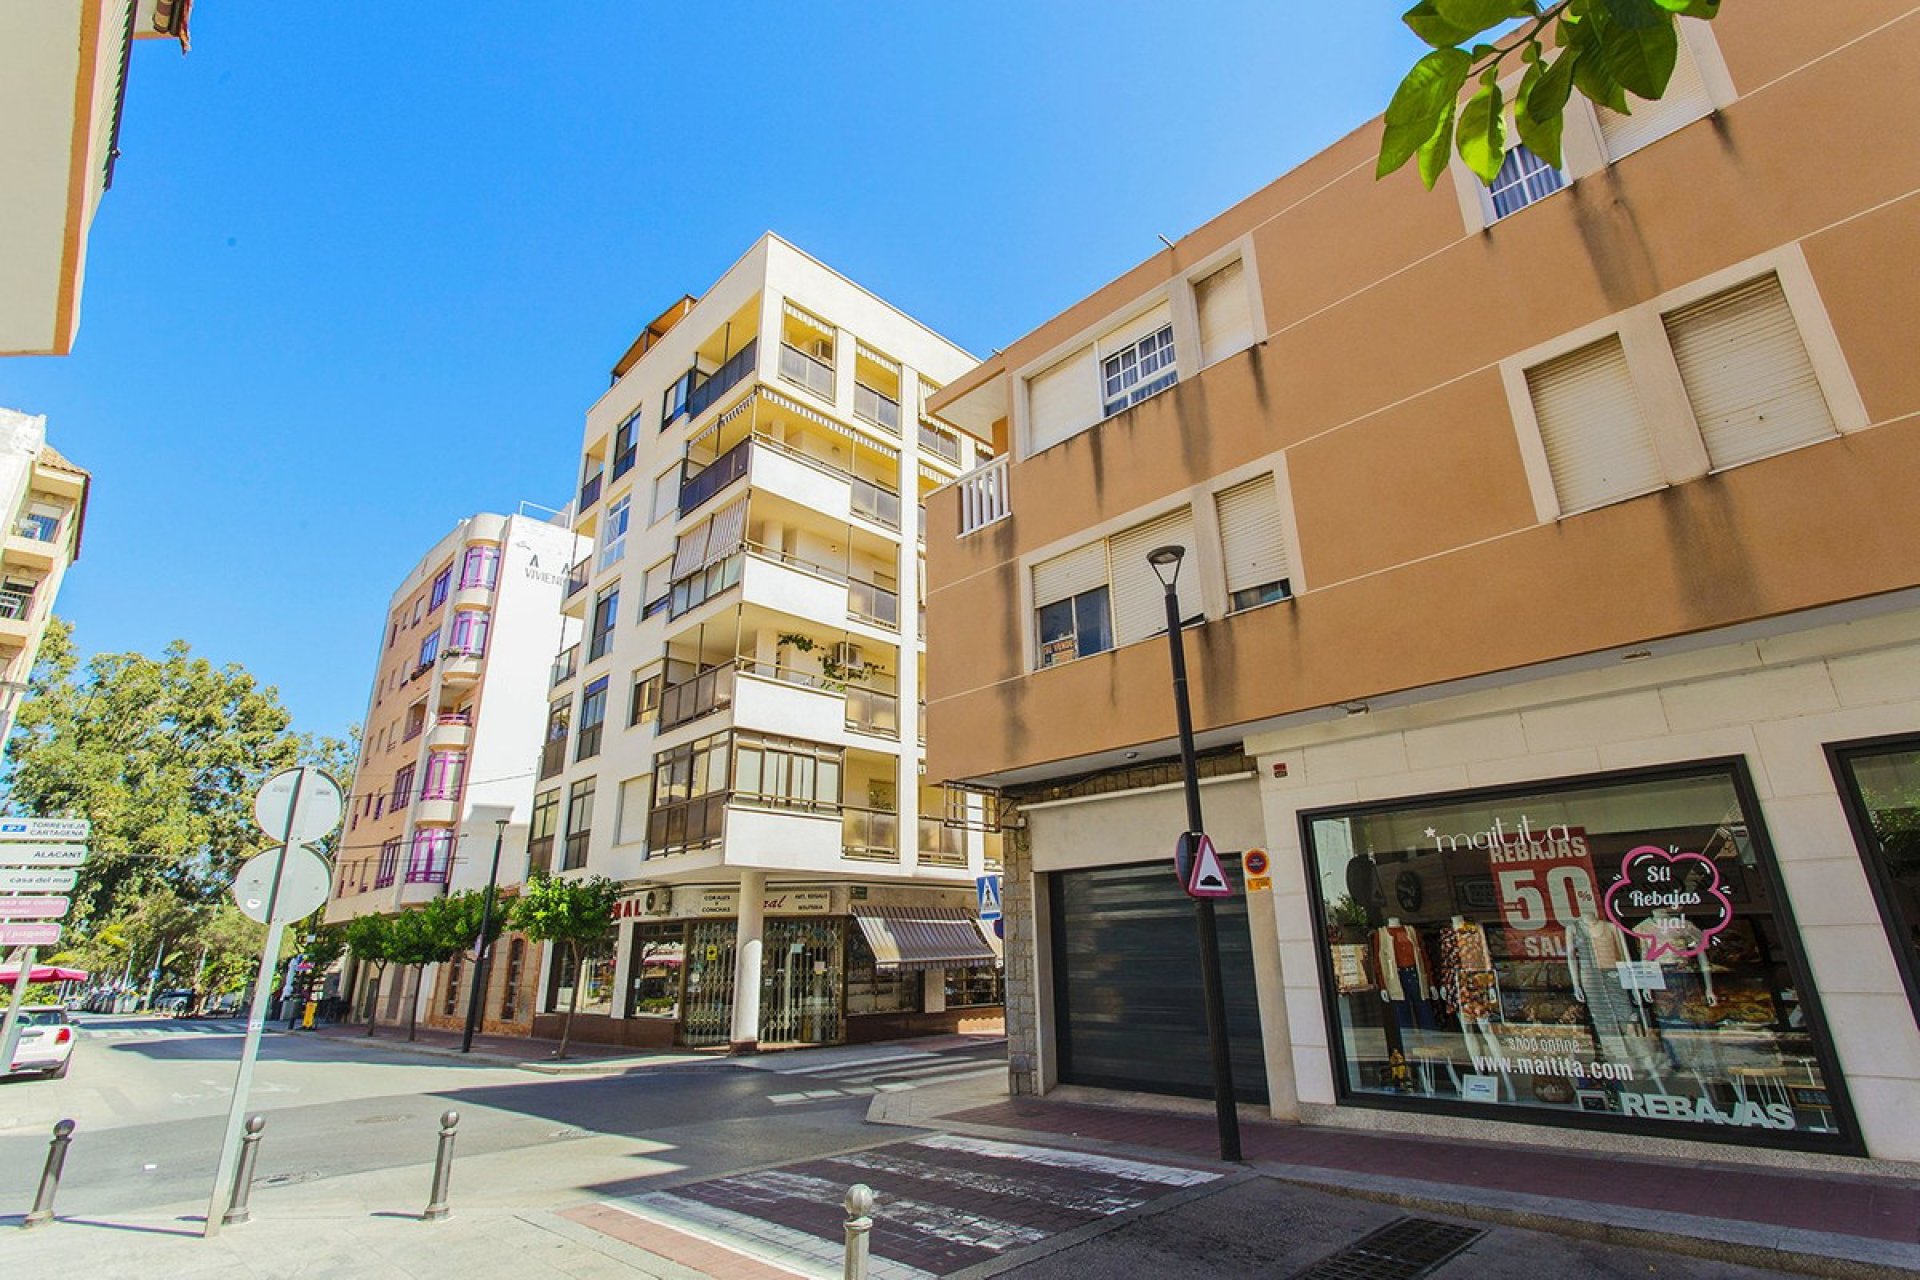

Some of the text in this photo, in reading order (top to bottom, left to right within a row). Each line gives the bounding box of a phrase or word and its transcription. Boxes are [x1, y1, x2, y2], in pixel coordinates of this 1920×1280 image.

[33, 850, 82, 858] ALACANT
[1489, 836, 1588, 865] REBAJAS
[611, 898, 642, 918] RAL
[1629, 889, 1702, 909] Rebajas
[1657, 913, 1686, 932] ya!
[1524, 935, 1569, 958] SAL
[1472, 1055, 1634, 1081] www.maitita.com
[1620, 1092, 1796, 1131] REBAJAS
